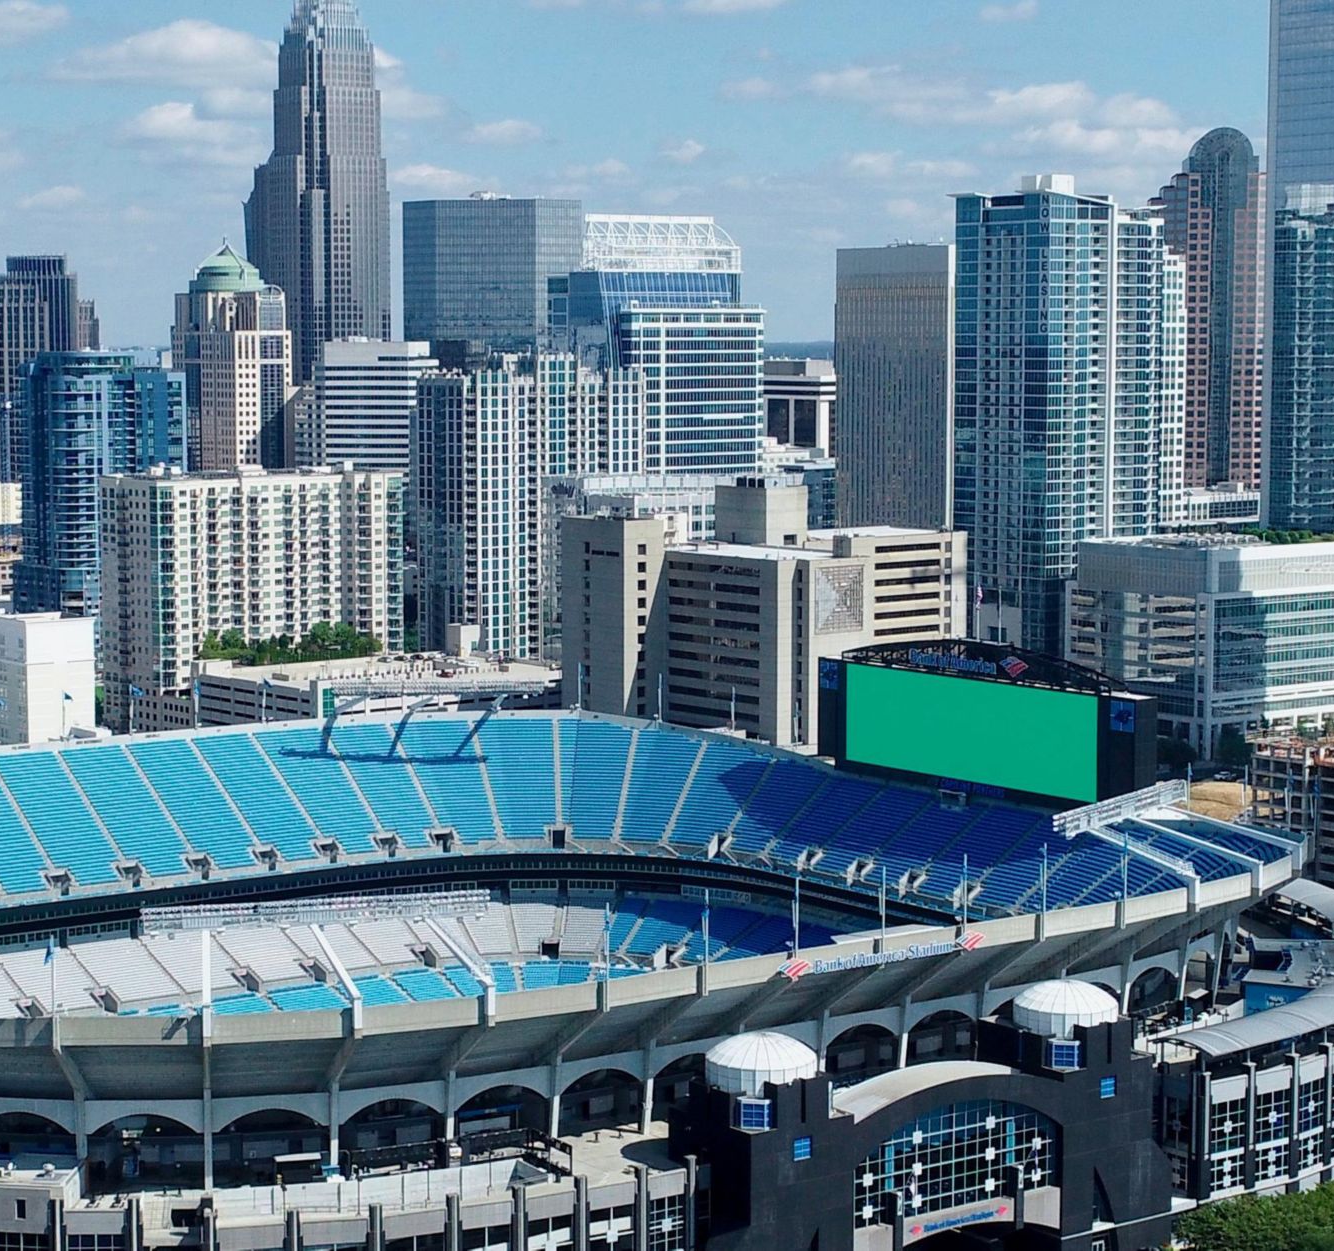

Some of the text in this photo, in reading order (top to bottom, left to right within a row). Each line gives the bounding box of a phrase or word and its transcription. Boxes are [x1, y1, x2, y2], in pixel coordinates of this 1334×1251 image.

[1039, 194, 1050, 333] NOW LEASING
[909, 648, 939, 667] Bank
[950, 652, 997, 675] America
[815, 941, 954, 974] Bank of America Stadium
